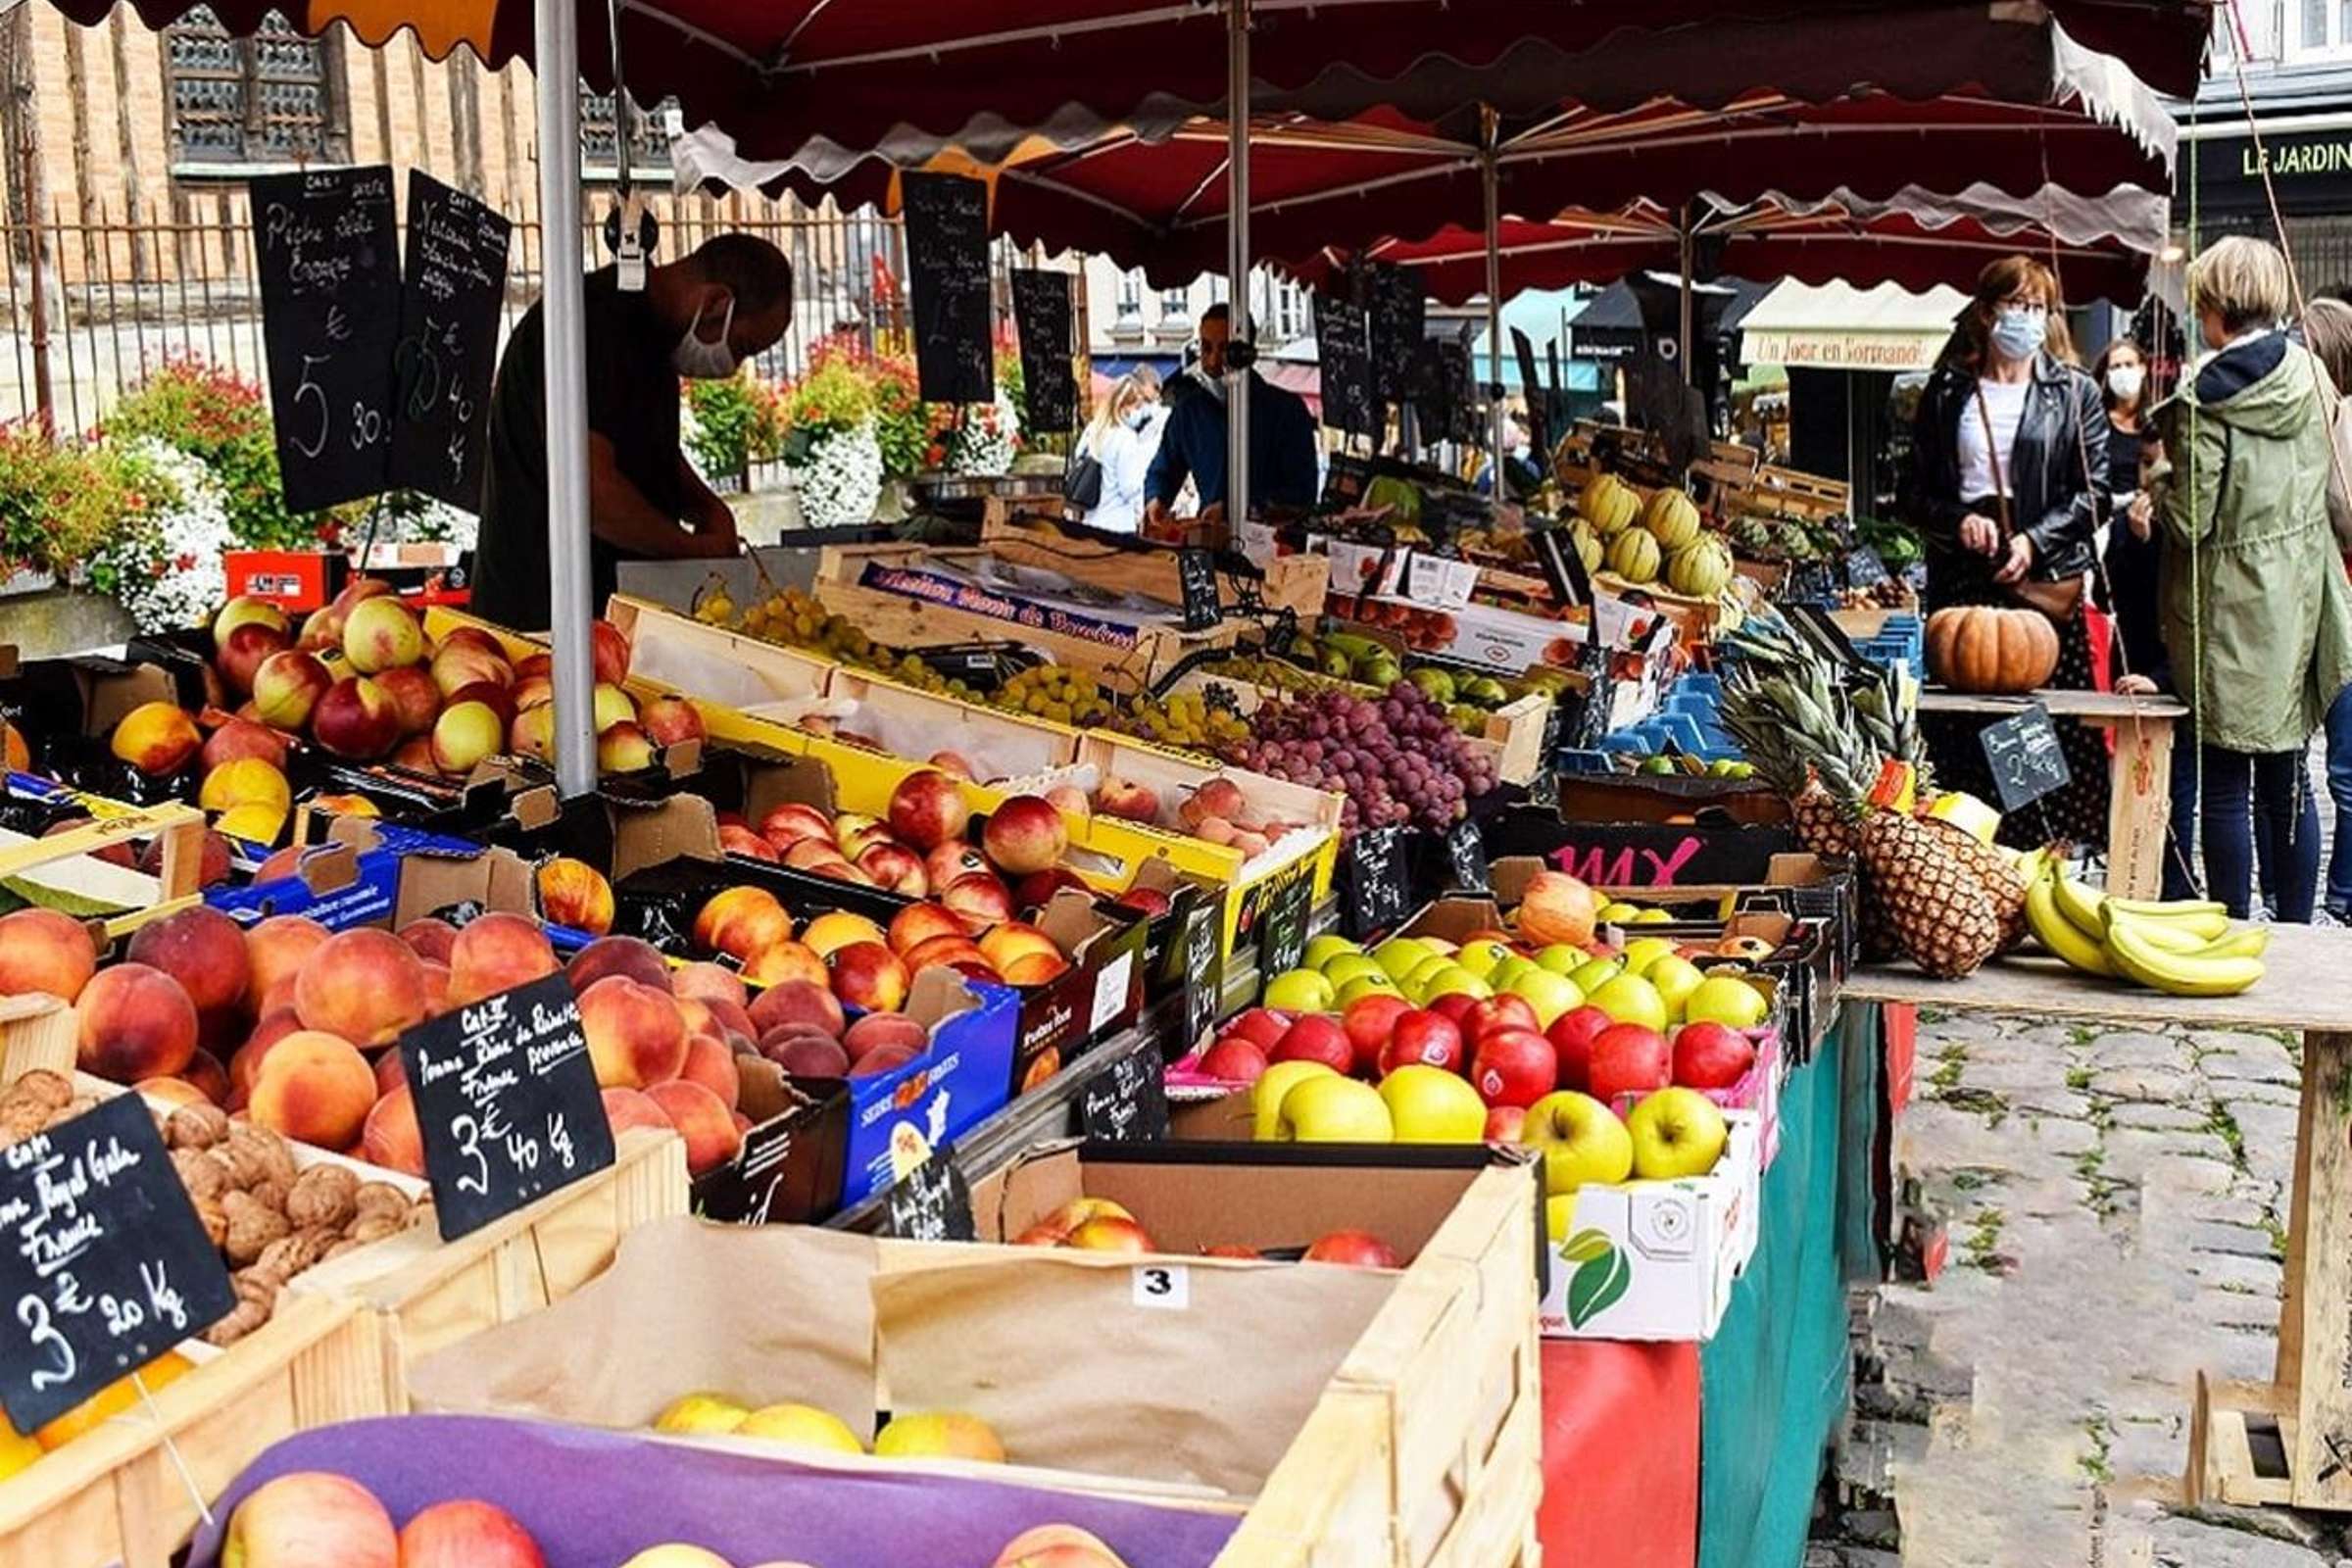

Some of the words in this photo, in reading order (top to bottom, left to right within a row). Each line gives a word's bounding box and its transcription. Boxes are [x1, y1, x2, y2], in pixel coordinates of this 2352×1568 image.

[2273, 142, 2352, 173] JARDIN
[289, 353, 331, 460] 5
[506, 1132, 539, 1174] 40
[139, 1258, 187, 1331] Kg
[1145, 1269, 1172, 1295] 3
